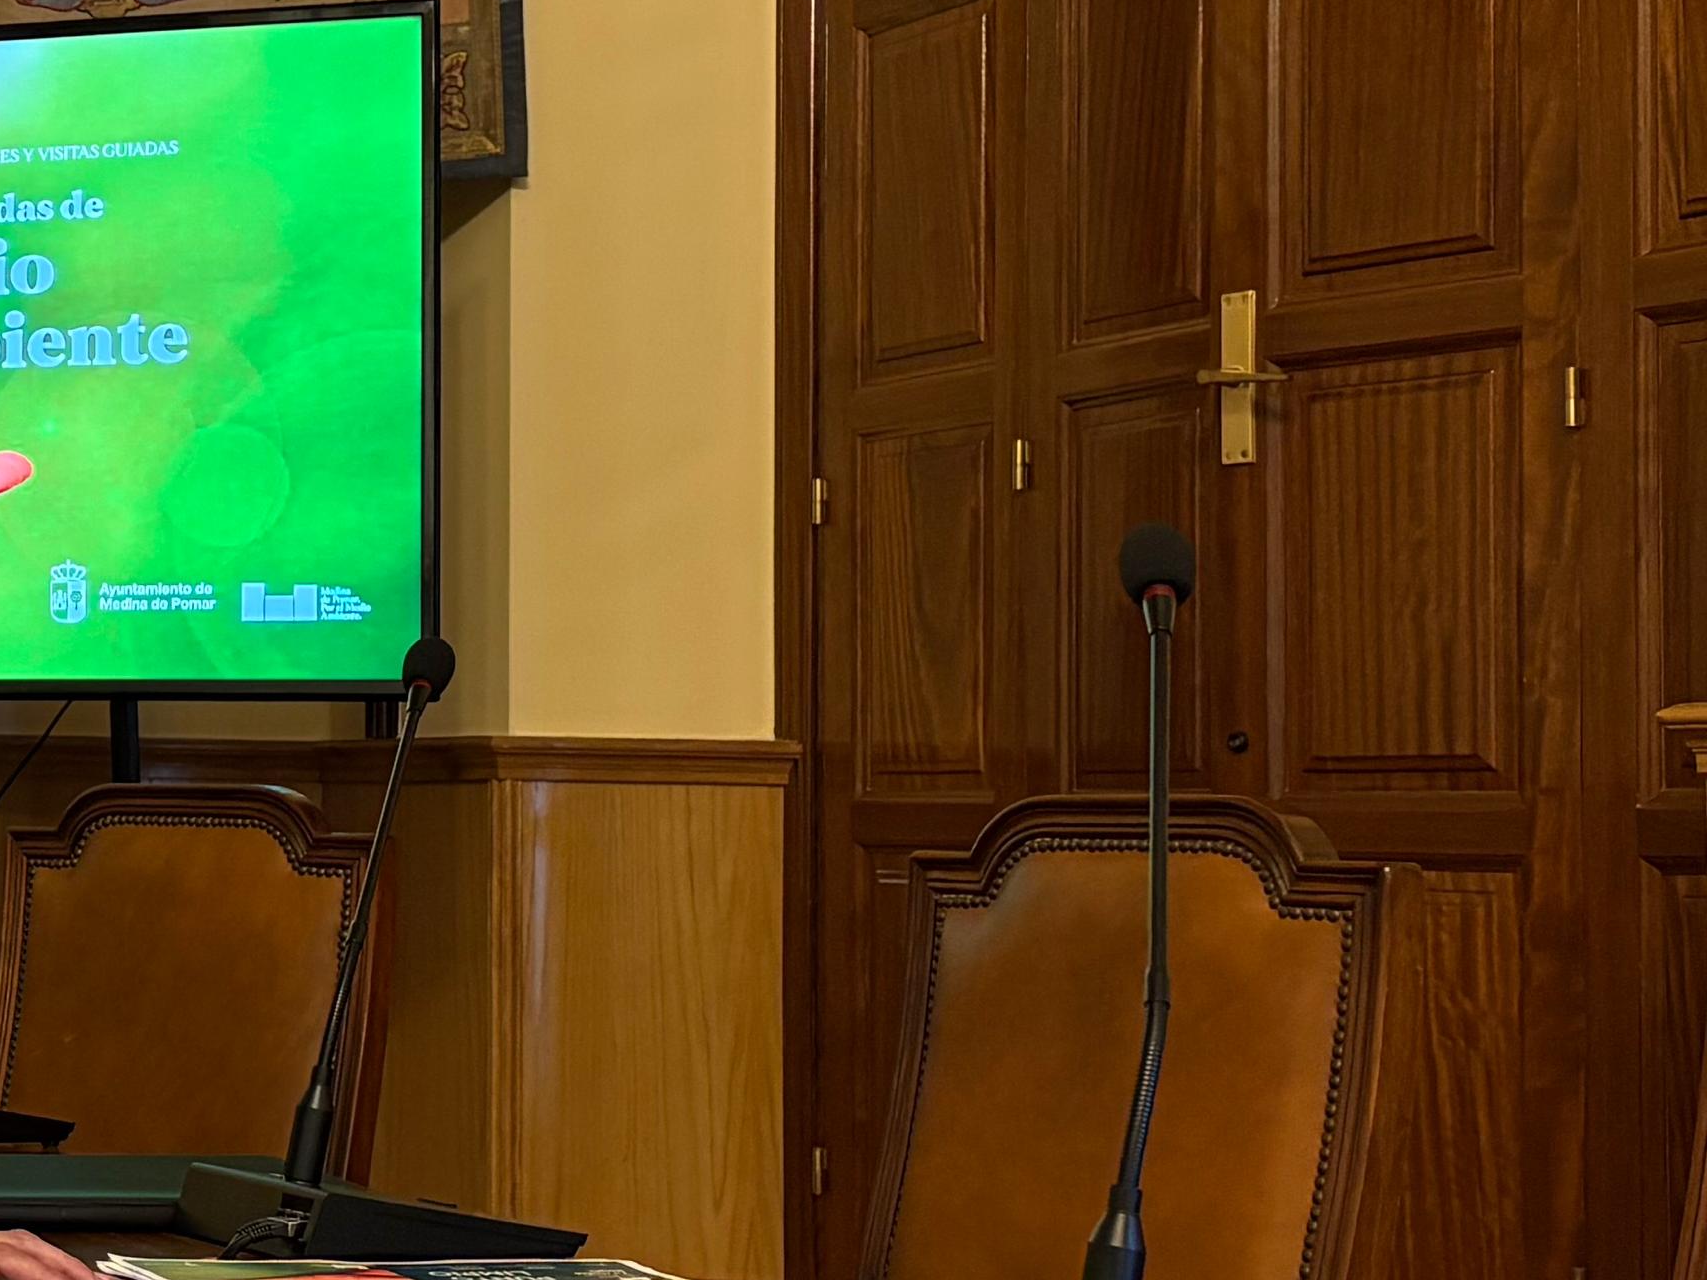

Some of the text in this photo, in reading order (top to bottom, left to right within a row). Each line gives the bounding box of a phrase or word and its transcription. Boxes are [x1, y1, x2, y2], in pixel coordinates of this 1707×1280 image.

[23, 147, 33, 162] Y
[37, 144, 100, 162] VISITAS
[102, 139, 180, 159] GUIADAS
[59, 188, 105, 220] de
[98, 581, 214, 598] Ayuntamiento de
[98, 596, 216, 611] Medina de Pomar
